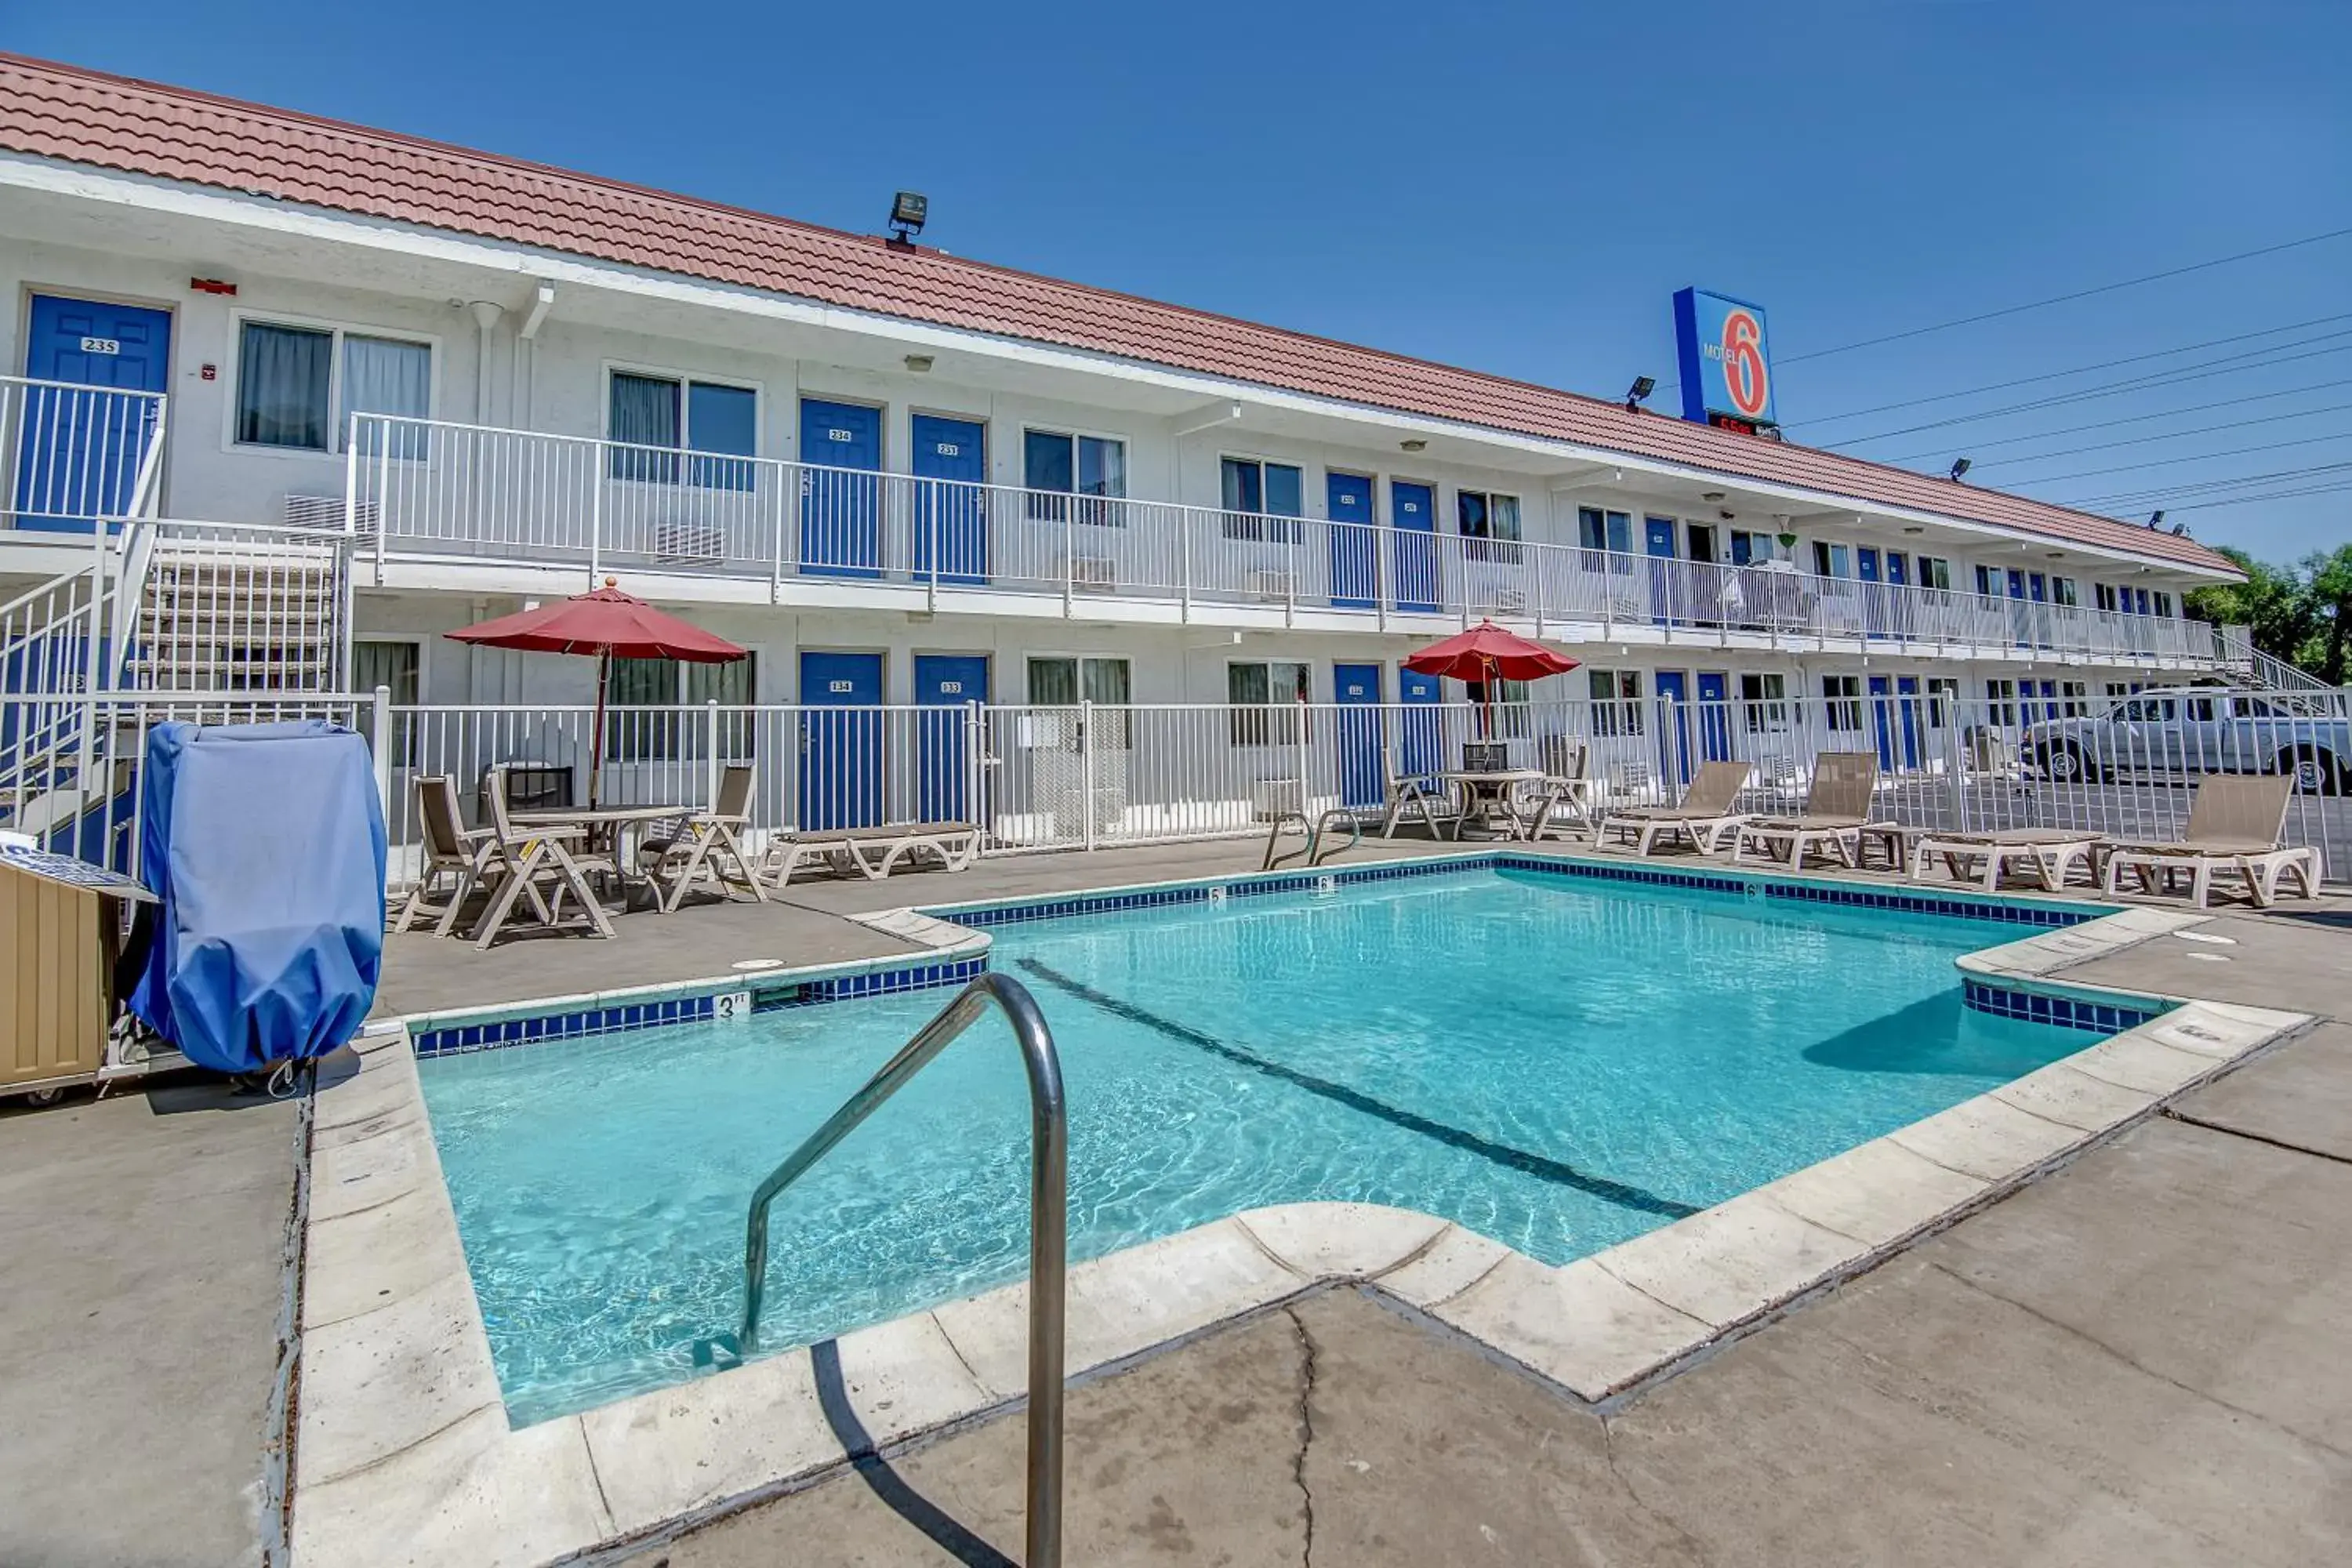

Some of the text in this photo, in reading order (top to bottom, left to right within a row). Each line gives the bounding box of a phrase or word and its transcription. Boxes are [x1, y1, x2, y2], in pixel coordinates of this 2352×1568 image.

[85, 339, 114, 352] 235
[1704, 310, 1767, 416] MOTEL 6
[720, 994, 746, 1018] 3 FT
